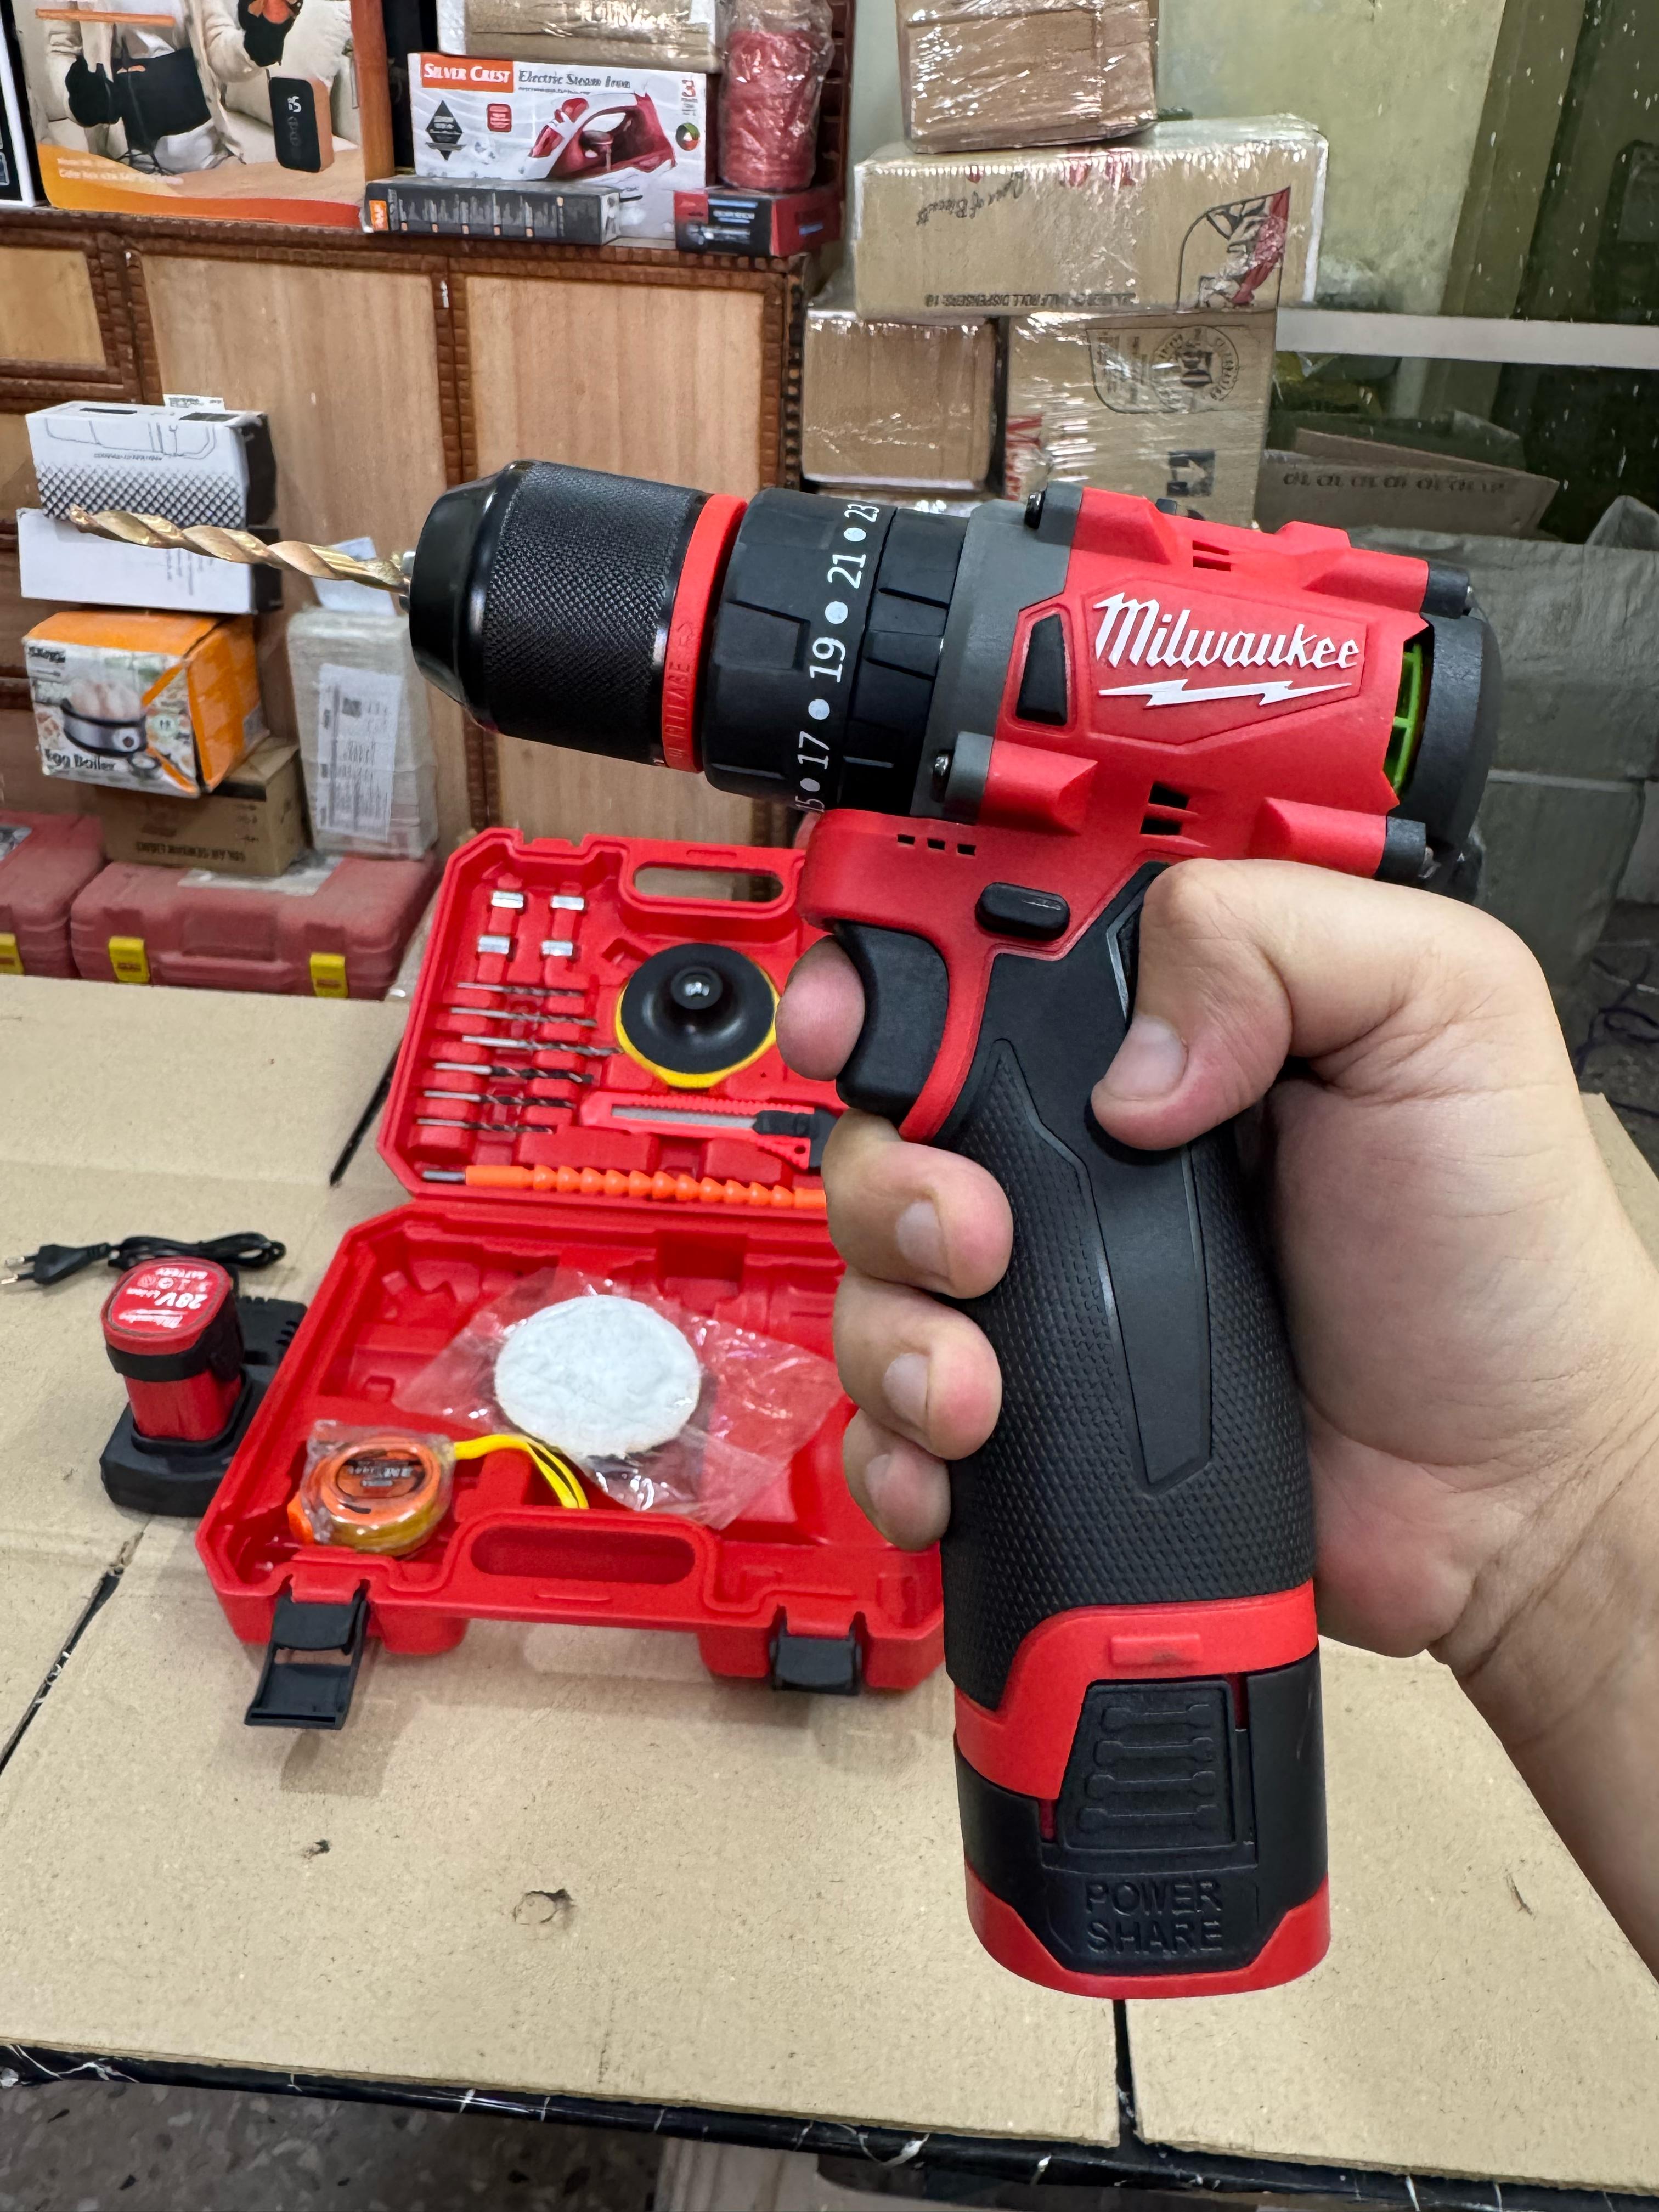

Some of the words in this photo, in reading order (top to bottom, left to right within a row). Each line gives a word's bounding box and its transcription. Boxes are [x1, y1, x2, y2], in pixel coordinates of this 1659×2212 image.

[844, 503, 879, 523] 23
[827, 554, 867, 589] 21
[1093, 592, 1359, 669] Milwaukee
[810, 636, 847, 683] 19
[797, 730, 831, 769] 17
[154, 1291, 208, 1310] 28V
[1085, 1879, 1224, 1915] POWER
[1086, 1918, 1224, 1955] SHARE
